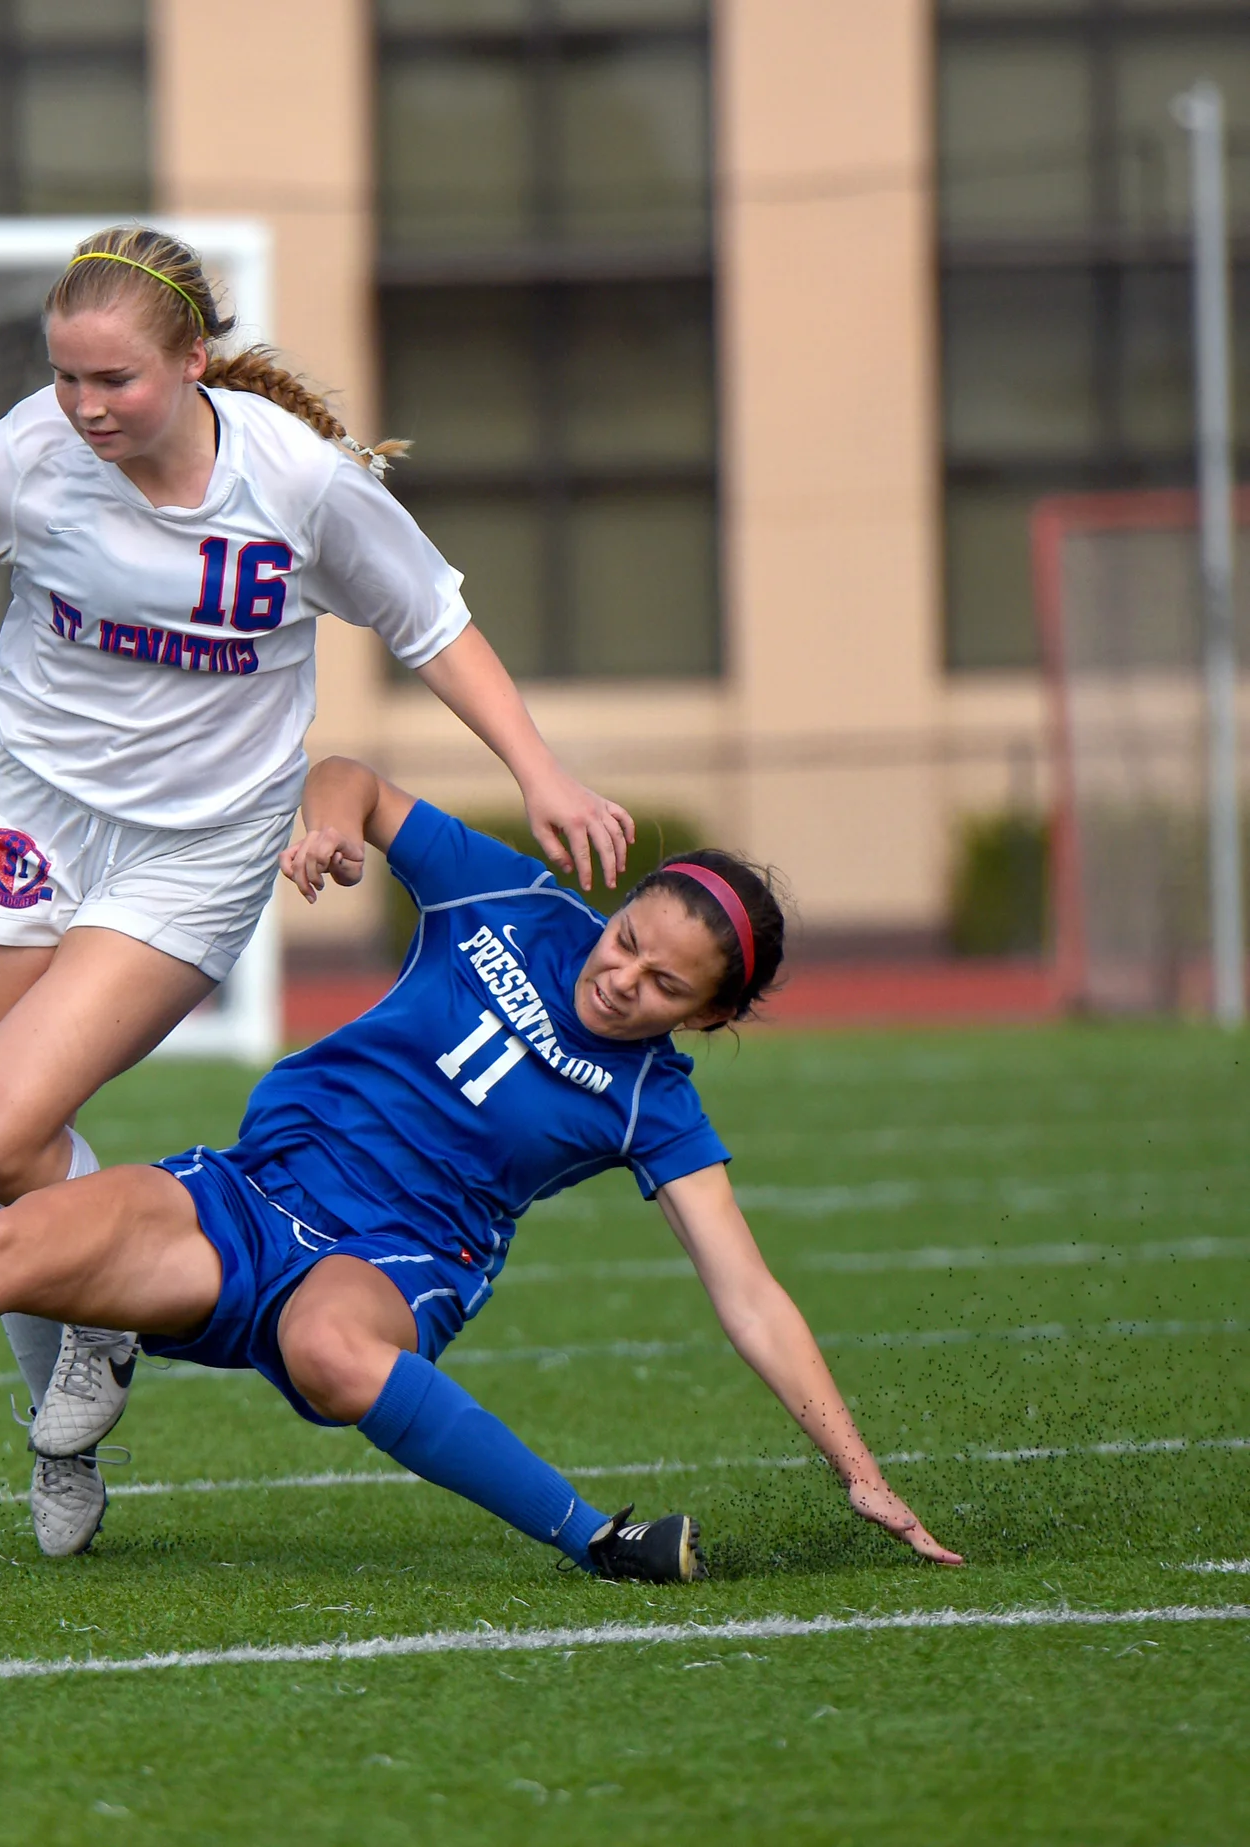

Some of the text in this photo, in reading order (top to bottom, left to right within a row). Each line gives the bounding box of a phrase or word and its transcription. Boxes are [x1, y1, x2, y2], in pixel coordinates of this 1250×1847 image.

[190, 536, 293, 632] 16
[99, 619, 259, 675] IGNATIUS
[435, 1009, 529, 1107] 11
[457, 925, 613, 1094] PRESENTATION
